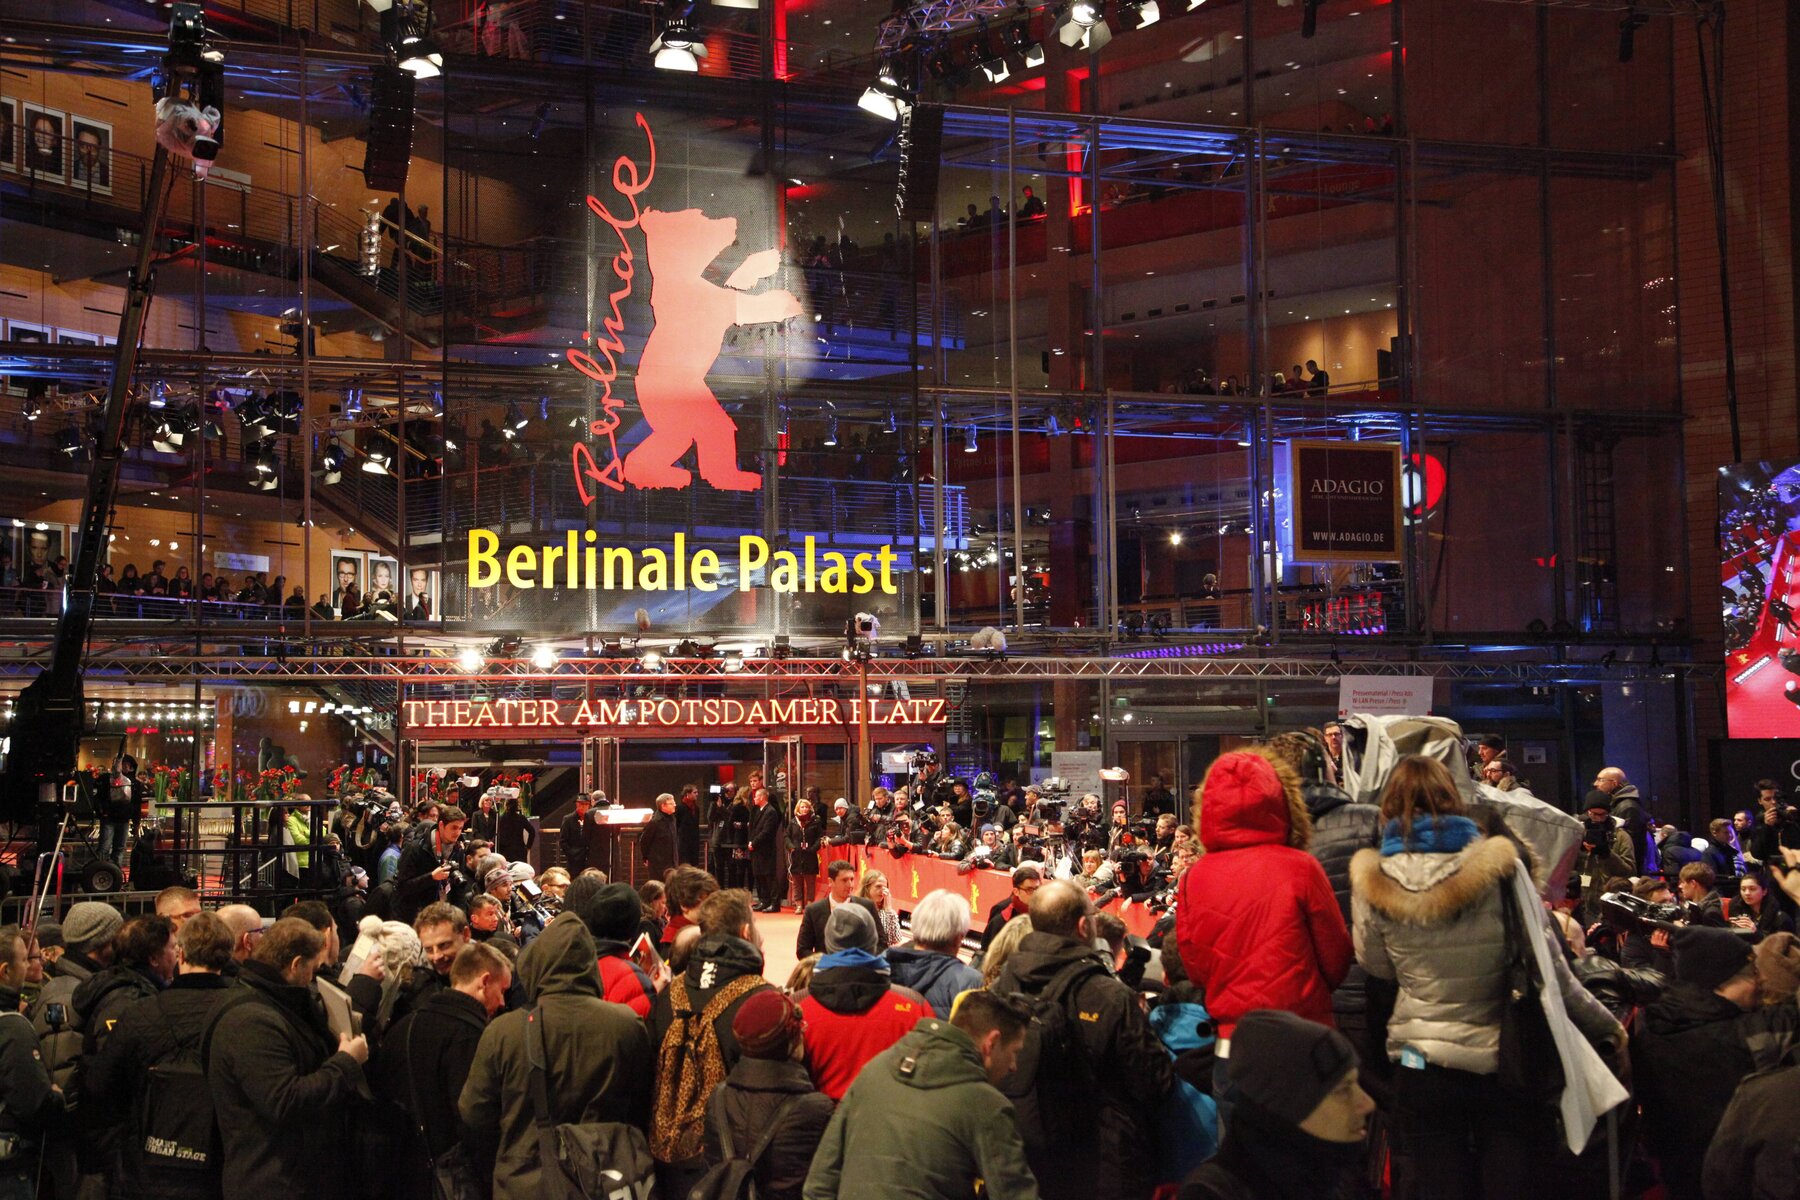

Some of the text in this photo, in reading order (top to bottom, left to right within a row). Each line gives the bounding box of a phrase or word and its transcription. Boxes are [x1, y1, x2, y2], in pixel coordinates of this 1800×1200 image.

[566, 112, 656, 506] Berlinale
[1311, 479, 1383, 495] ADAGIO
[1312, 532, 1384, 542] WWW.ADAGIO.DE
[467, 528, 898, 595] Berlinale Palast
[402, 699, 565, 727] THEATER
[572, 699, 630, 727] AM
[637, 699, 843, 726] POTSDAMER
[146, 1136, 178, 1149] SMART
[145, 1144, 207, 1162] URBAN STAGE
